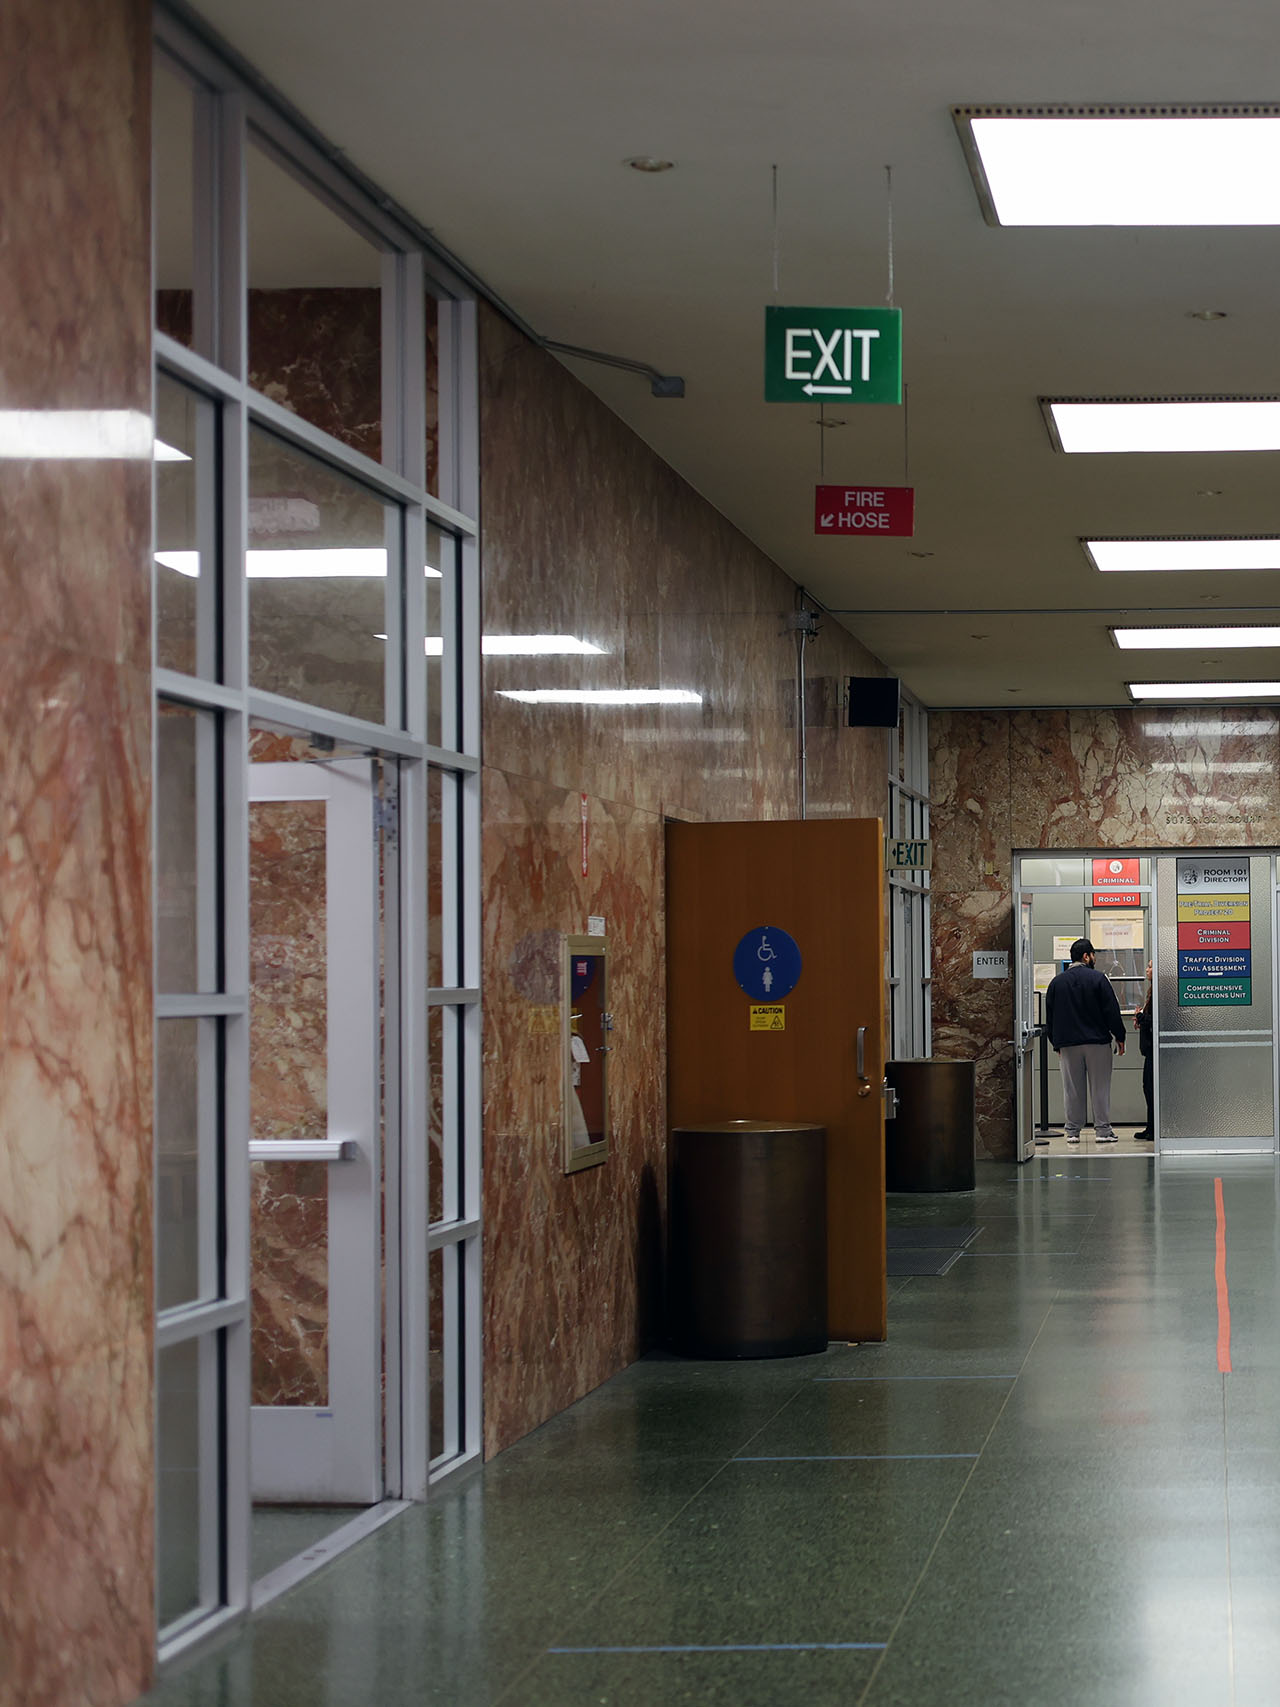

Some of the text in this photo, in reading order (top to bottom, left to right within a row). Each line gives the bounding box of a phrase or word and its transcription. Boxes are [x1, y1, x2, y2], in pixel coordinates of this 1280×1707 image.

[785, 329, 880, 381] EXIT
[844, 491, 885, 507] FIRE
[838, 512, 890, 529] HOSE
[896, 842, 927, 866] EXIT
[976, 957, 1005, 966] ENTER
